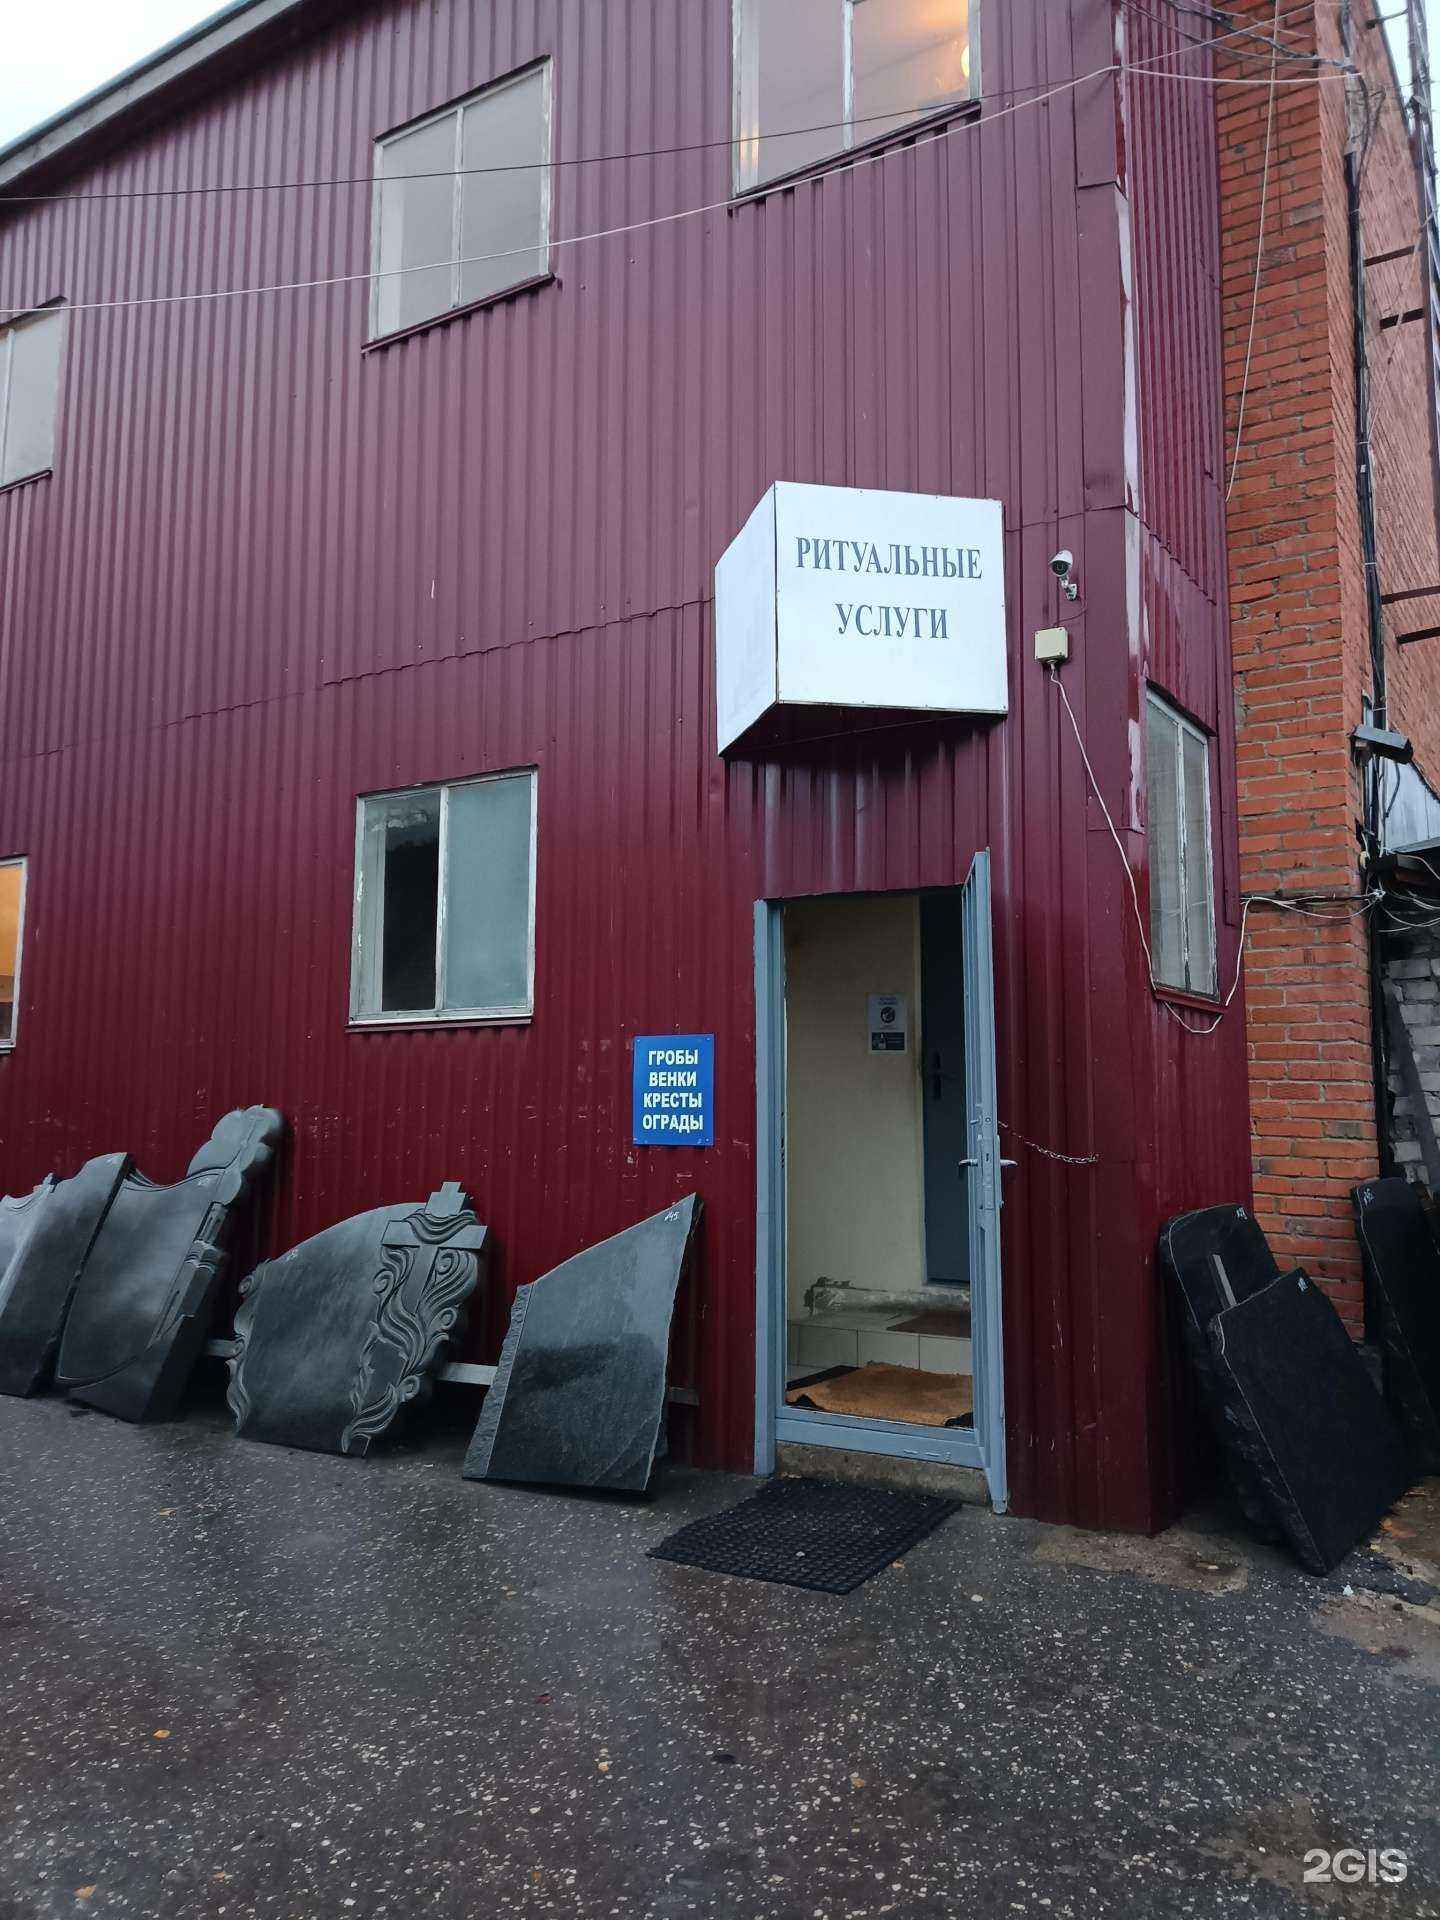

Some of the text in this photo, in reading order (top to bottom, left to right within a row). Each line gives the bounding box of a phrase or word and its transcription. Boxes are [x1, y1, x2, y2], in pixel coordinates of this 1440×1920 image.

[796, 536, 983, 579] РИТУАЛЬНЫЕ
[835, 603, 950, 639] УСЛУГИ
[648, 1049, 698, 1066] ГРОБЫ
[649, 1071, 697, 1087] ВЕНКИ
[643, 1092, 702, 1108] КРЕСТЫ
[642, 1114, 703, 1133] ОГРАДЫ
